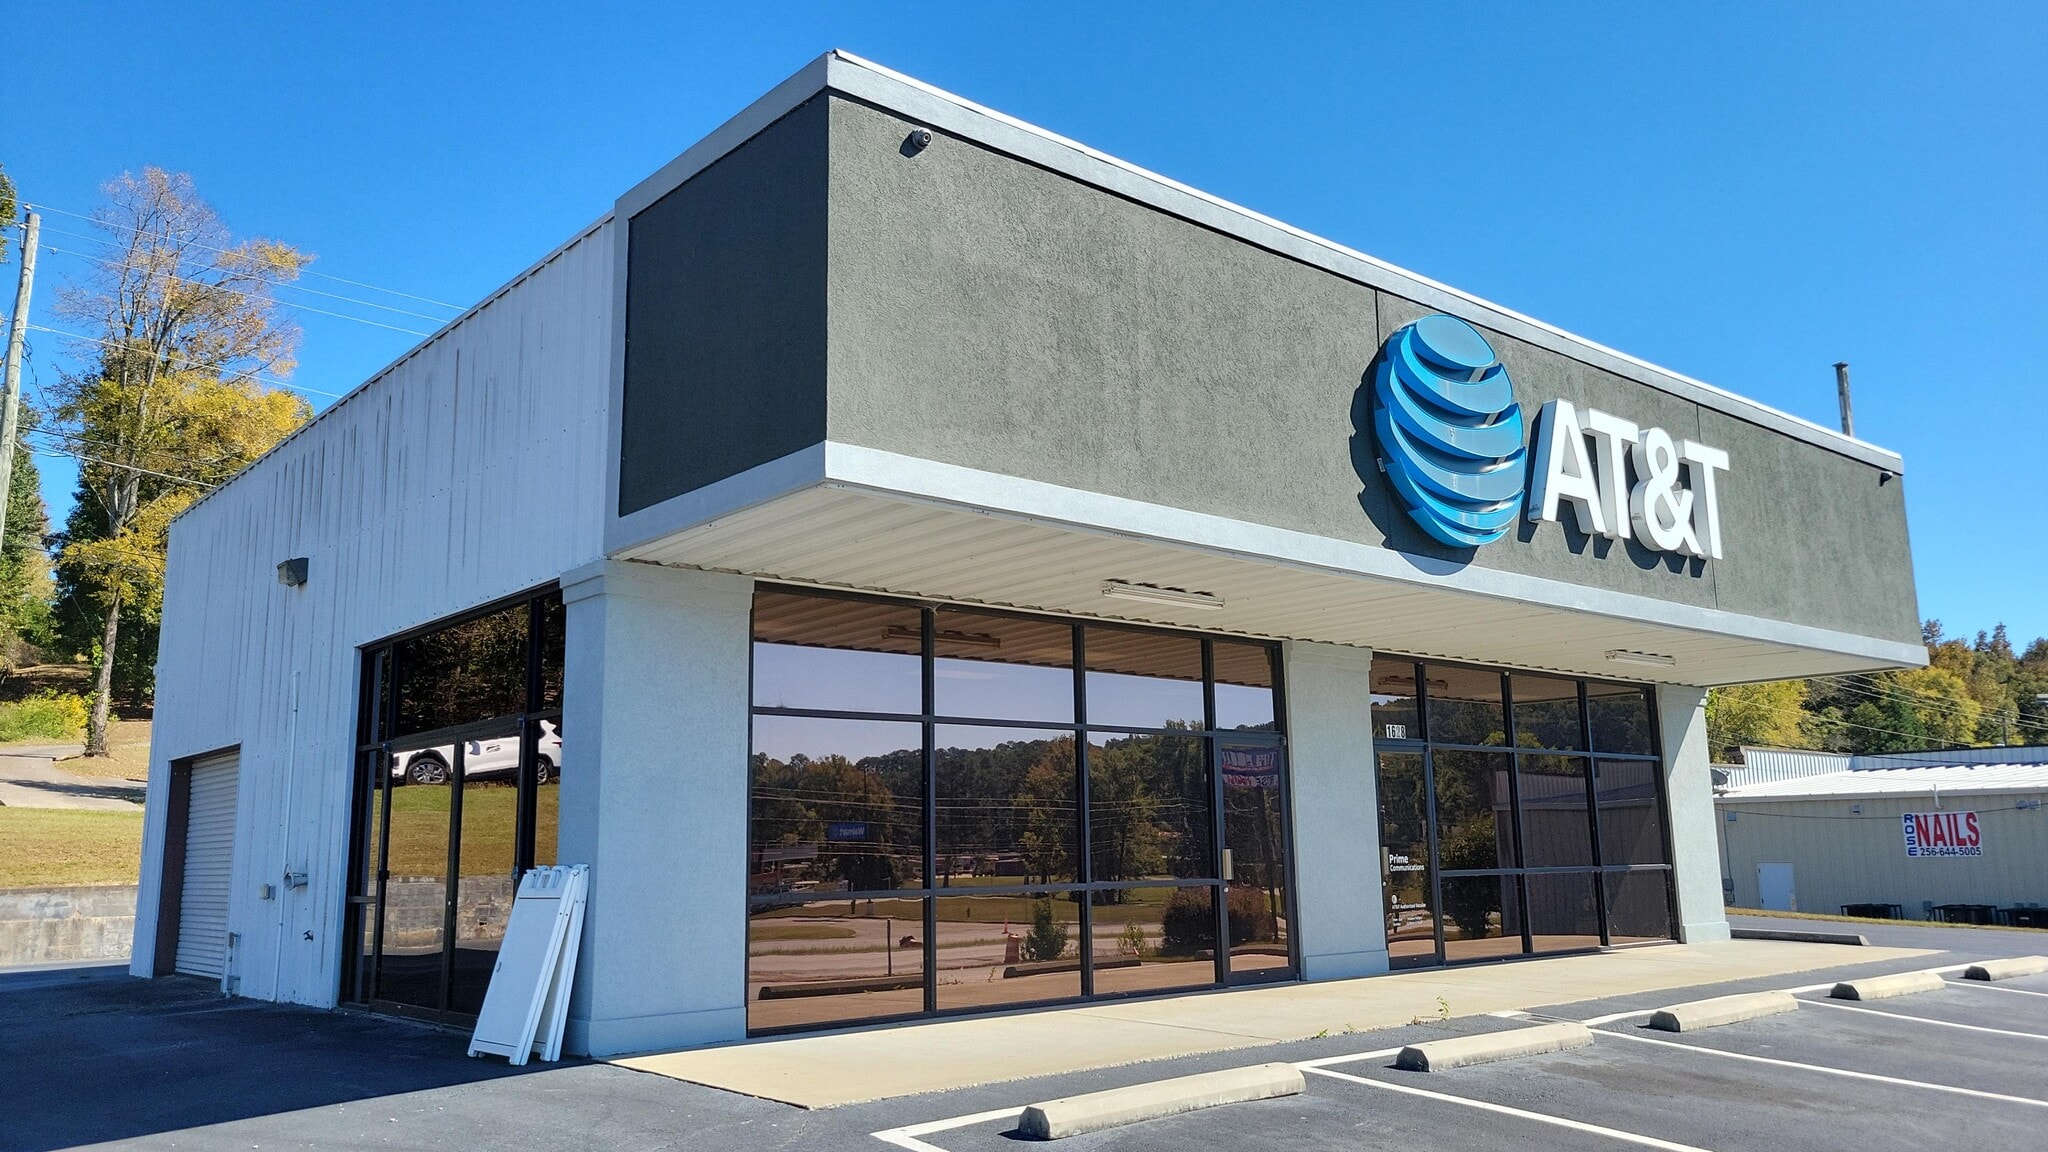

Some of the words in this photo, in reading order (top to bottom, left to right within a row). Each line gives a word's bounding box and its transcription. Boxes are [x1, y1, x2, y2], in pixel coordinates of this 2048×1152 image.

[1540, 398, 1730, 560] AT&T
[1904, 813, 1917, 856] ROSE
[1914, 812, 1980, 847] NAILS
[1389, 853, 1409, 864] Prime
[1920, 847, 1982, 856] 256-644-5005
